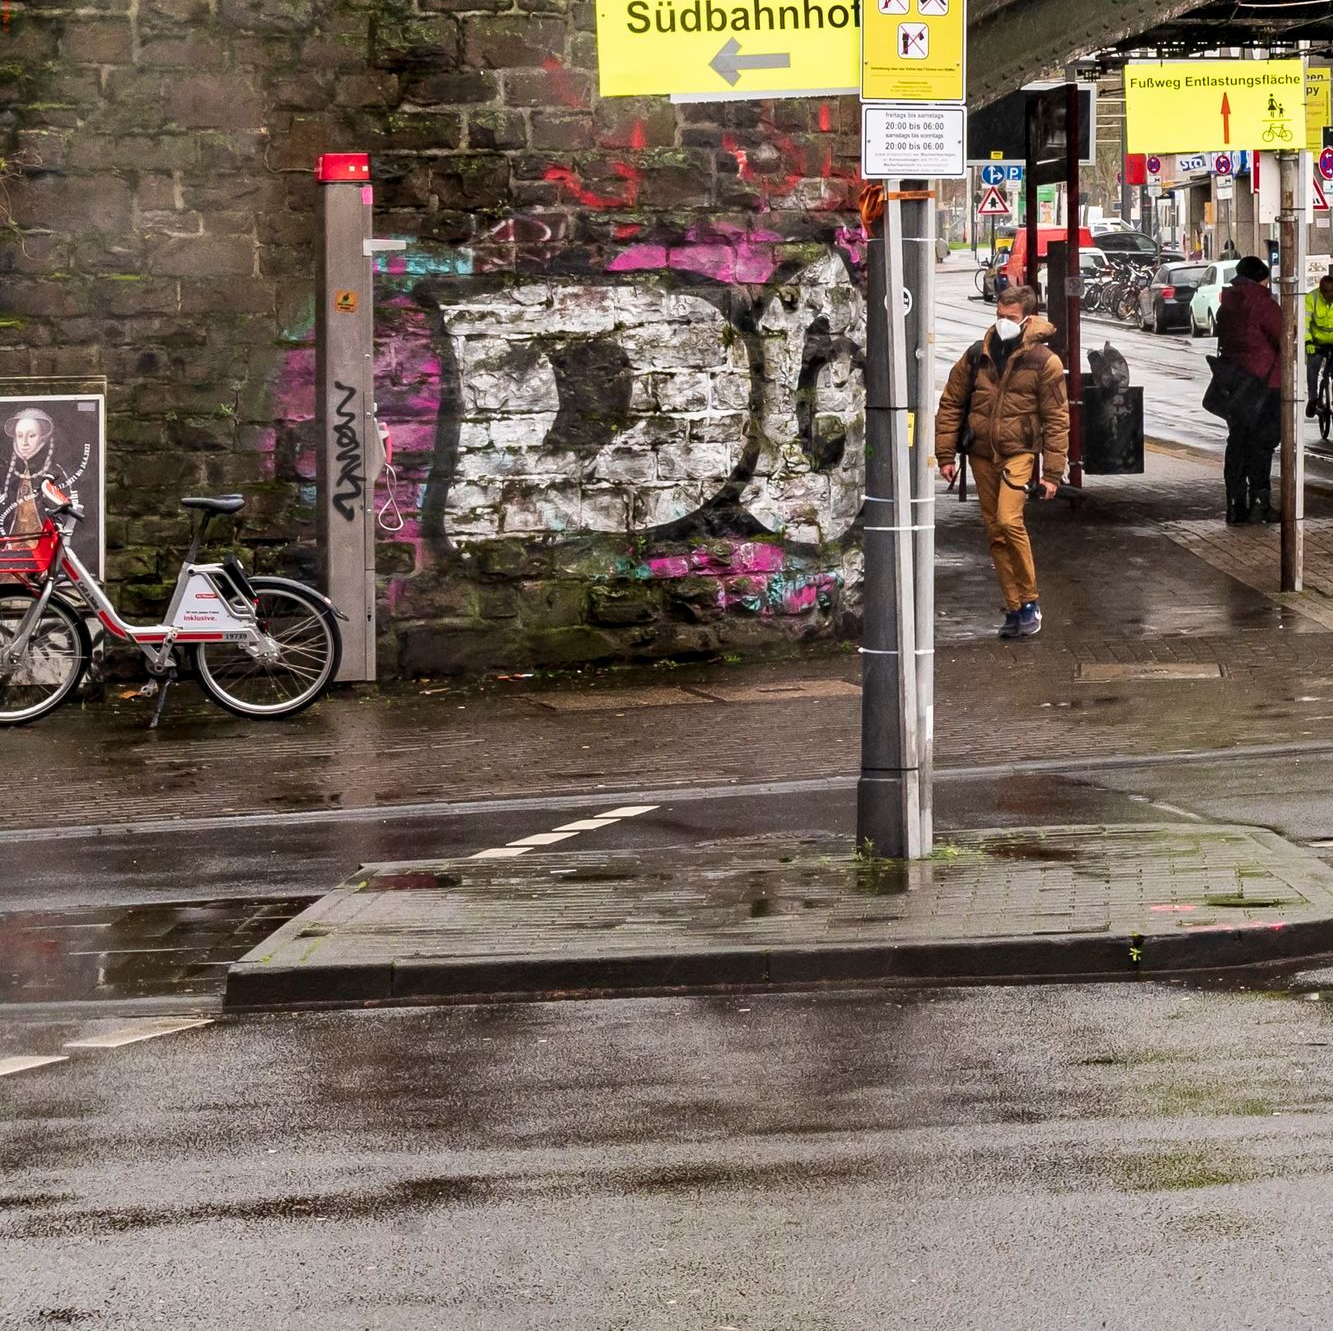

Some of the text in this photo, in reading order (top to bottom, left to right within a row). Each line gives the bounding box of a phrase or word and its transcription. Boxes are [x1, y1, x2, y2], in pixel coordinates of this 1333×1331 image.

[1130, 74, 1301, 90] Fußweg Entlastungsfläche
[885, 122, 944, 130] 20:00 bis 06:00
[885, 142, 944, 150] 20:00 bis 06:00
[1009, 167, 1018, 180] P
